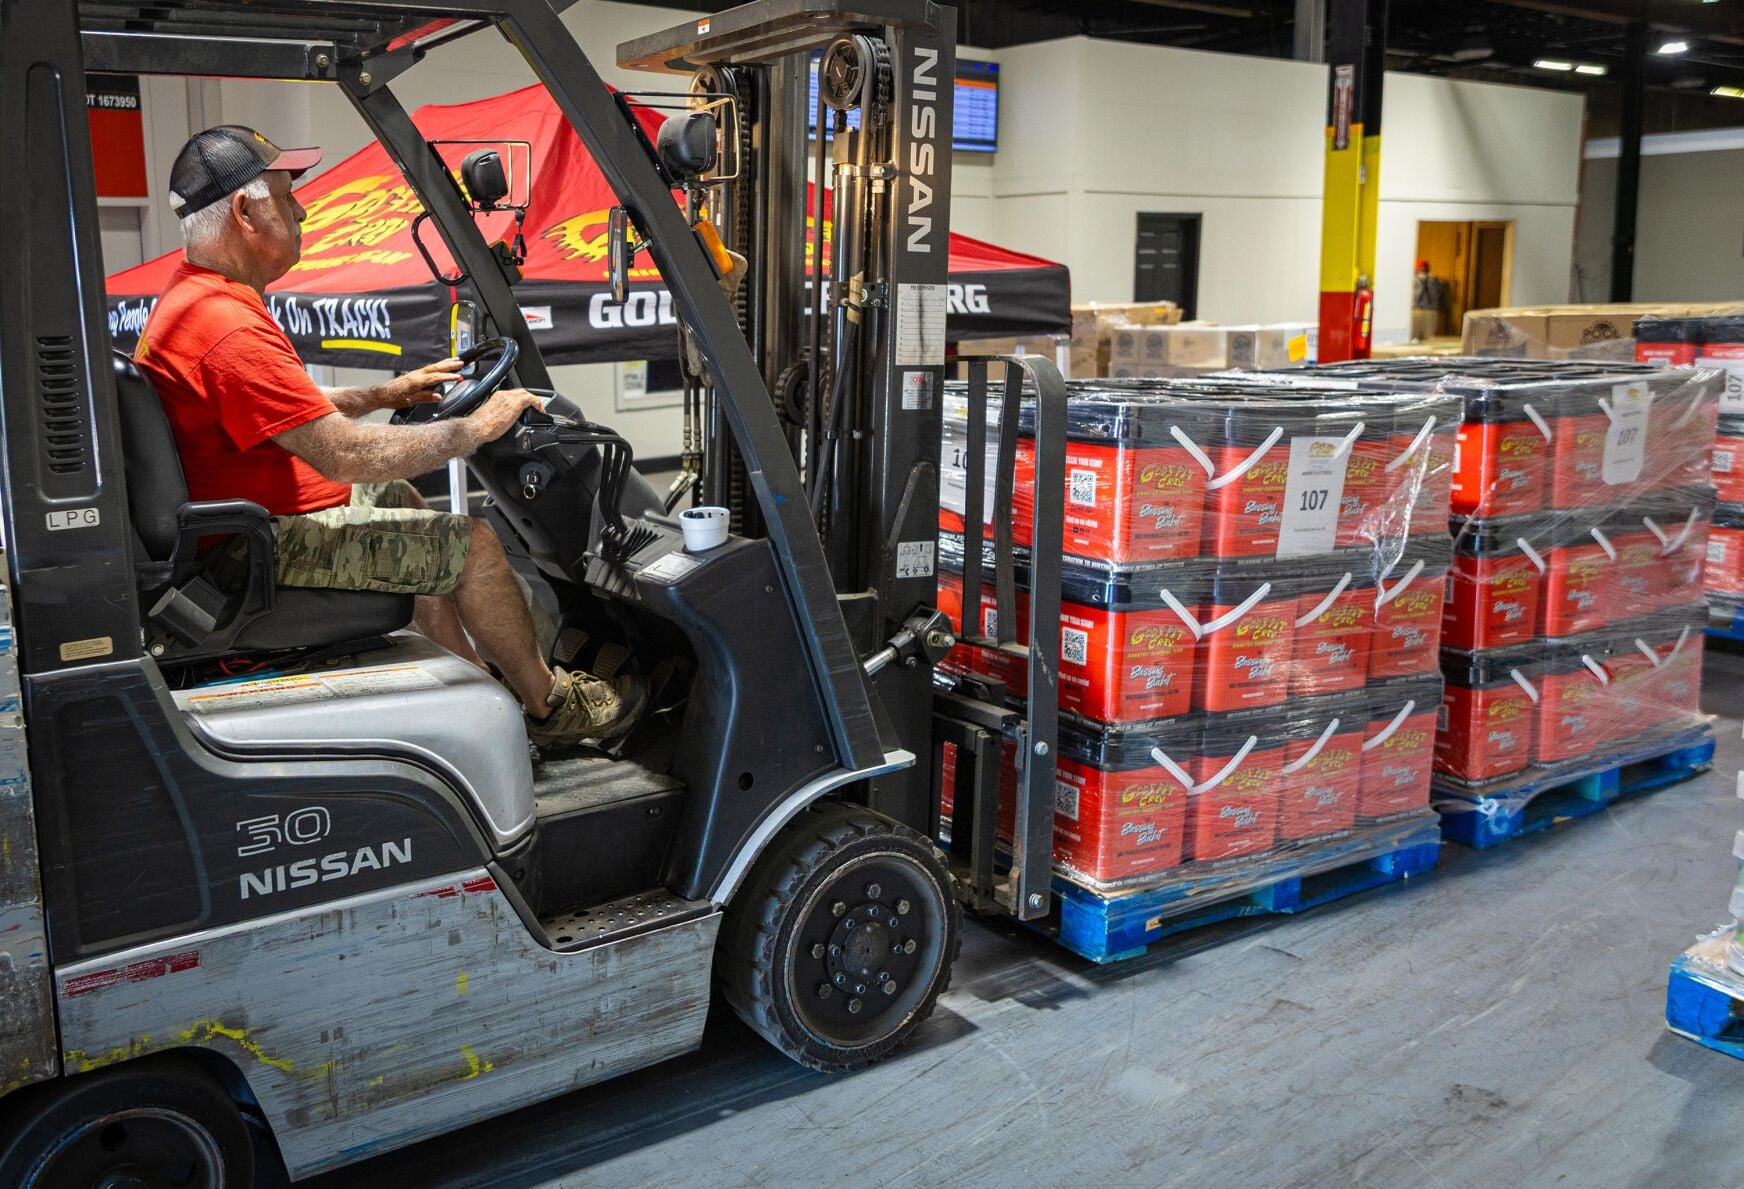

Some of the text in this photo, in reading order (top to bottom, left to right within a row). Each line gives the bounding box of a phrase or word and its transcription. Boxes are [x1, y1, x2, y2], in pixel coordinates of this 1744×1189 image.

[98, 94, 137, 108] 1673950
[906, 47, 938, 253] NISSAN
[285, 296, 312, 335] On
[312, 297, 391, 339] TRACK!
[1726, 374, 1743, 401] 107
[1299, 489, 1329, 511] 107
[48, 509, 97, 529] LPG
[236, 806, 331, 857] 30
[239, 838, 413, 900] NISSAN
